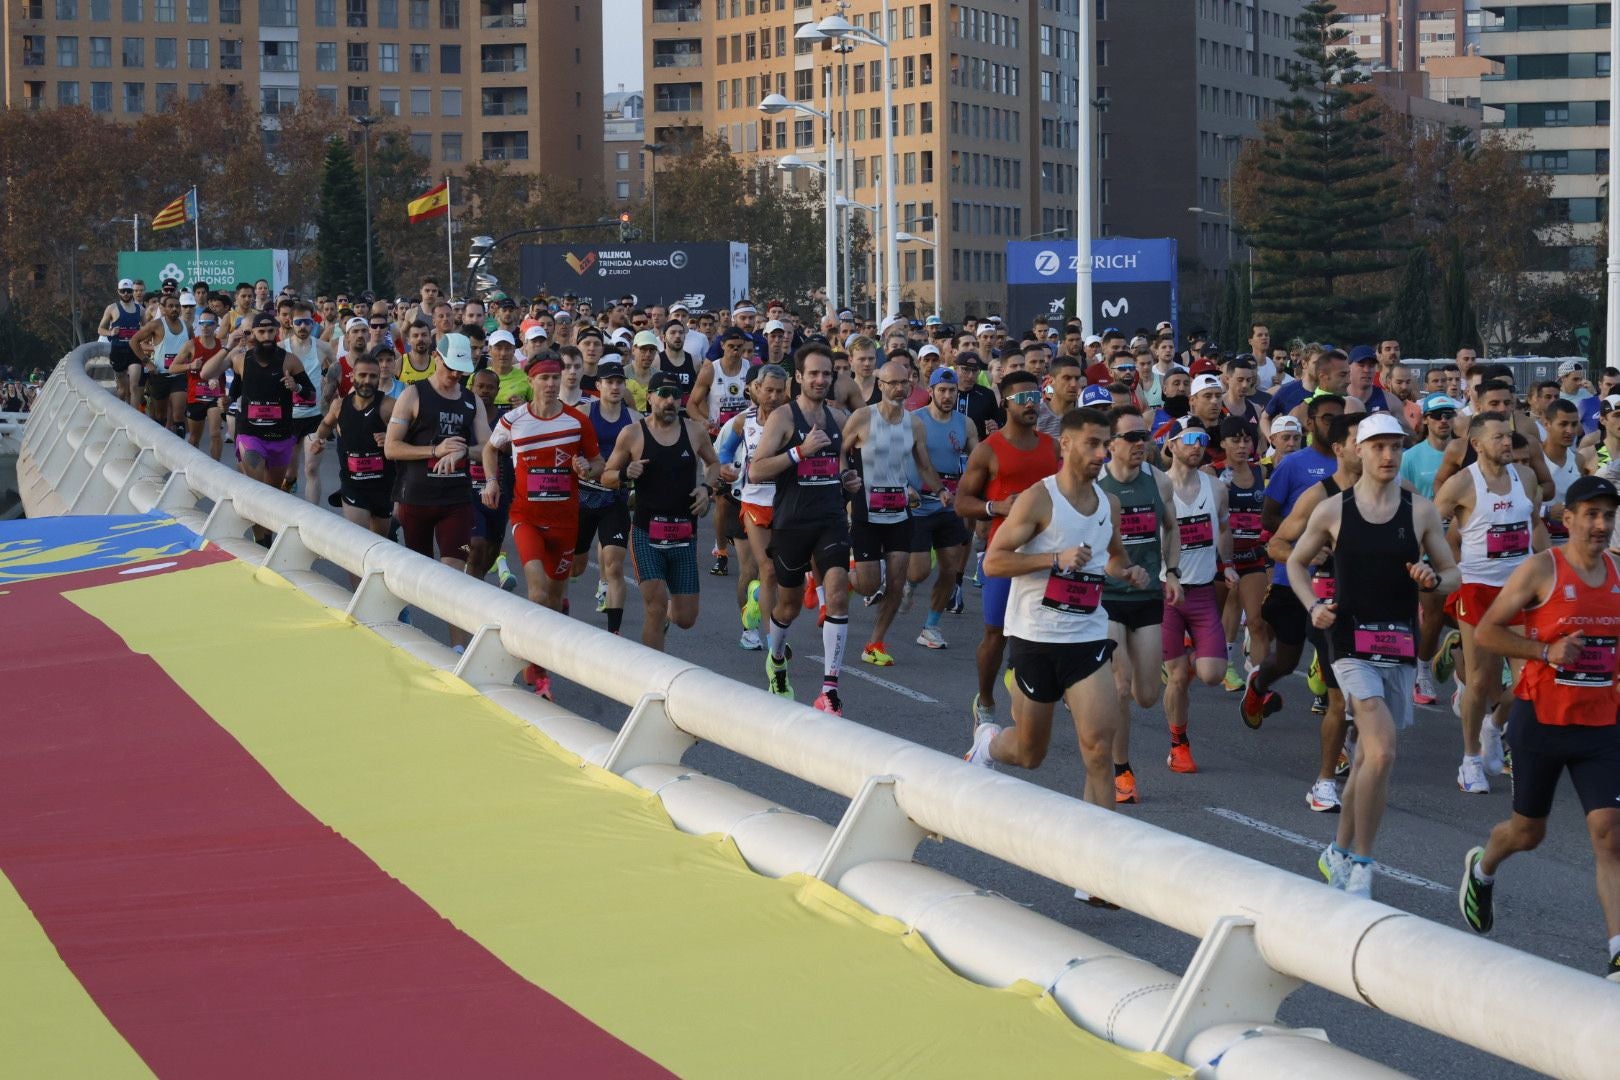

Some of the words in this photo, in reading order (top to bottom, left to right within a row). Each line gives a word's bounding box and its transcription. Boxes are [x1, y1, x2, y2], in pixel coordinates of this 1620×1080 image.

[598, 250, 632, 259] VALENCIA
[598, 259, 632, 267] TRINIDAD
[633, 258, 669, 267] ALFONSO
[1068, 254, 1137, 270] ZRICH
[187, 267, 235, 276] TRINIDAD
[439, 411, 465, 425] RUN
